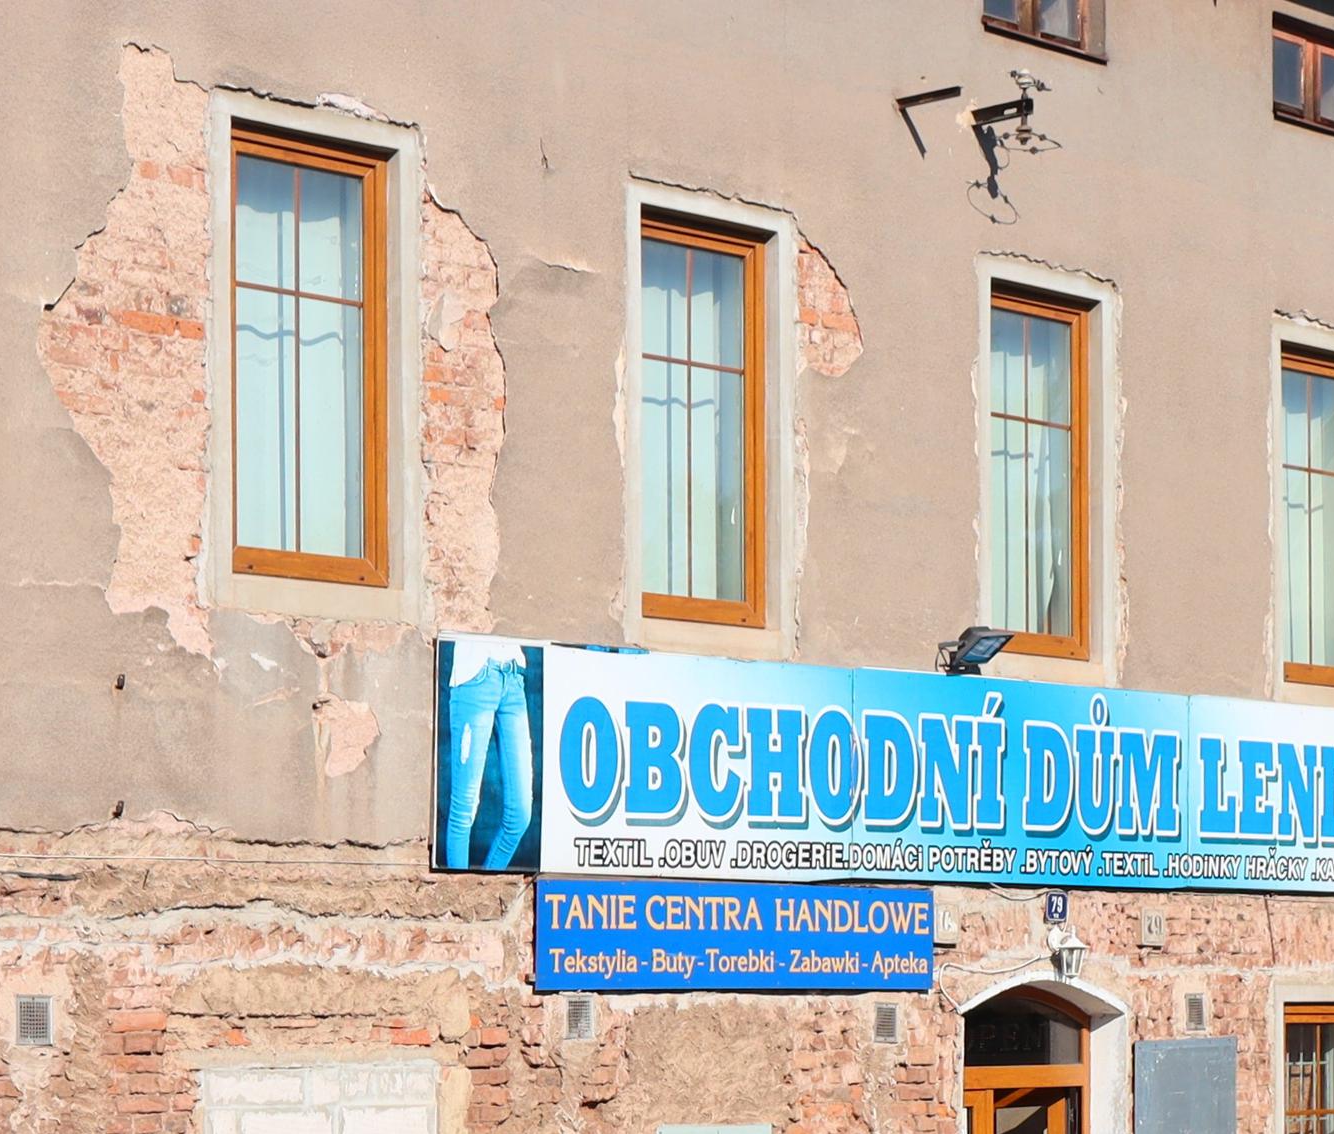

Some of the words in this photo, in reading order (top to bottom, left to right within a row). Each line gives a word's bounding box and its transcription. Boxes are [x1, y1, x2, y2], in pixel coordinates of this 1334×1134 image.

[559, 692, 1006, 832] OBCHODNÍ
[1023, 693, 1180, 839] DŮM
[575, 838, 653, 868] TEXTIL
[545, 894, 637, 930] TANIE
[645, 895, 763, 931] CENTRA
[775, 898, 929, 935] HANDLOWE
[1051, 896, 1063, 913] 79
[549, 948, 637, 980] Tekstylia
[652, 948, 696, 980] Buty
[705, 948, 774, 973] Torebki
[789, 949, 860, 974] Zabawki
[871, 950, 928, 980] Apteka
